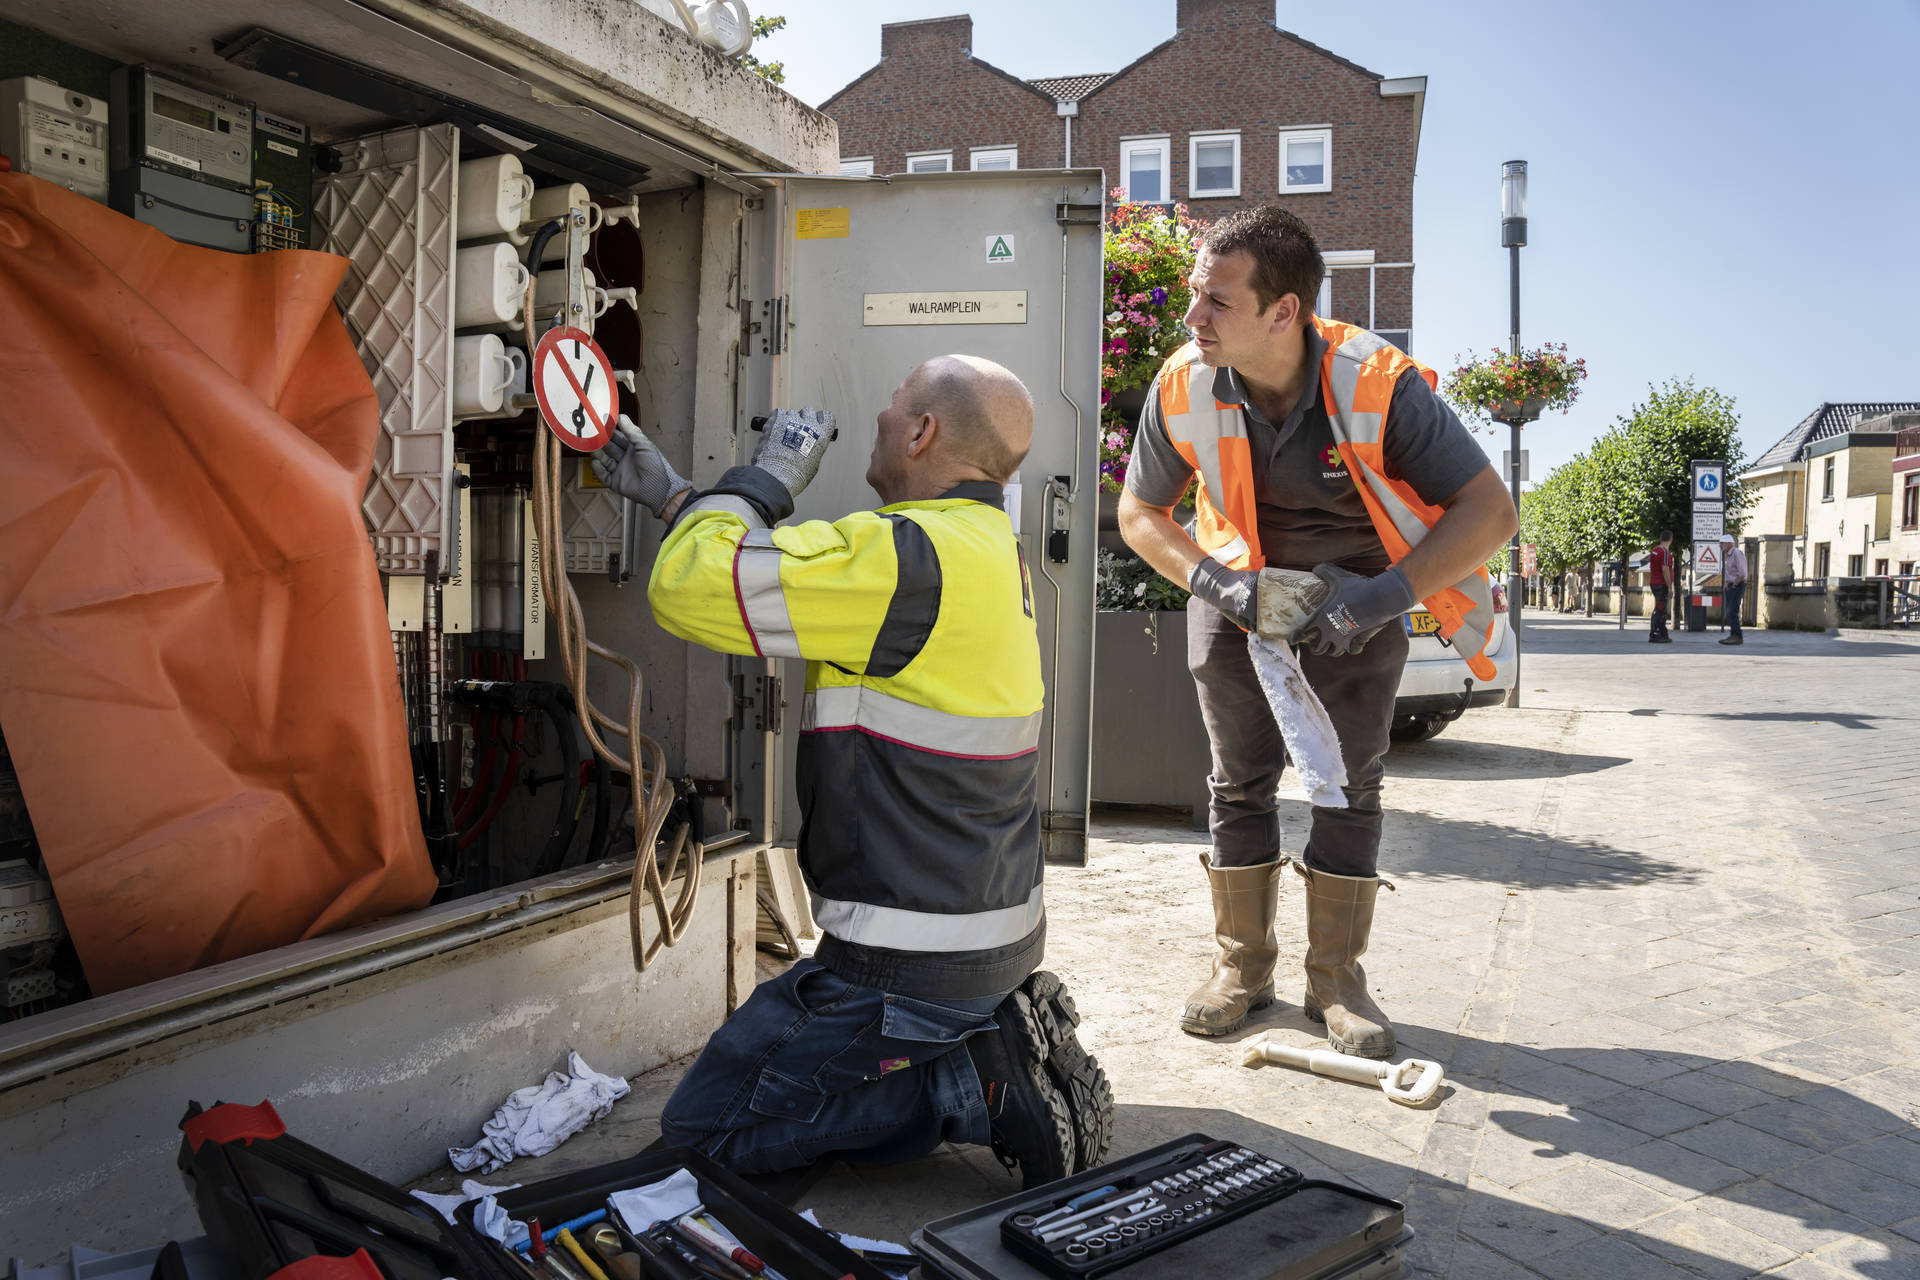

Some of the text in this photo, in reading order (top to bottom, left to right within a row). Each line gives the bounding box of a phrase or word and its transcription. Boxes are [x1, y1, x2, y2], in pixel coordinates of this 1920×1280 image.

[994, 242, 1006, 255] A
[909, 301, 981, 314] WALRAMPLEIN
[531, 538, 540, 623] TRANSFORMATOR
